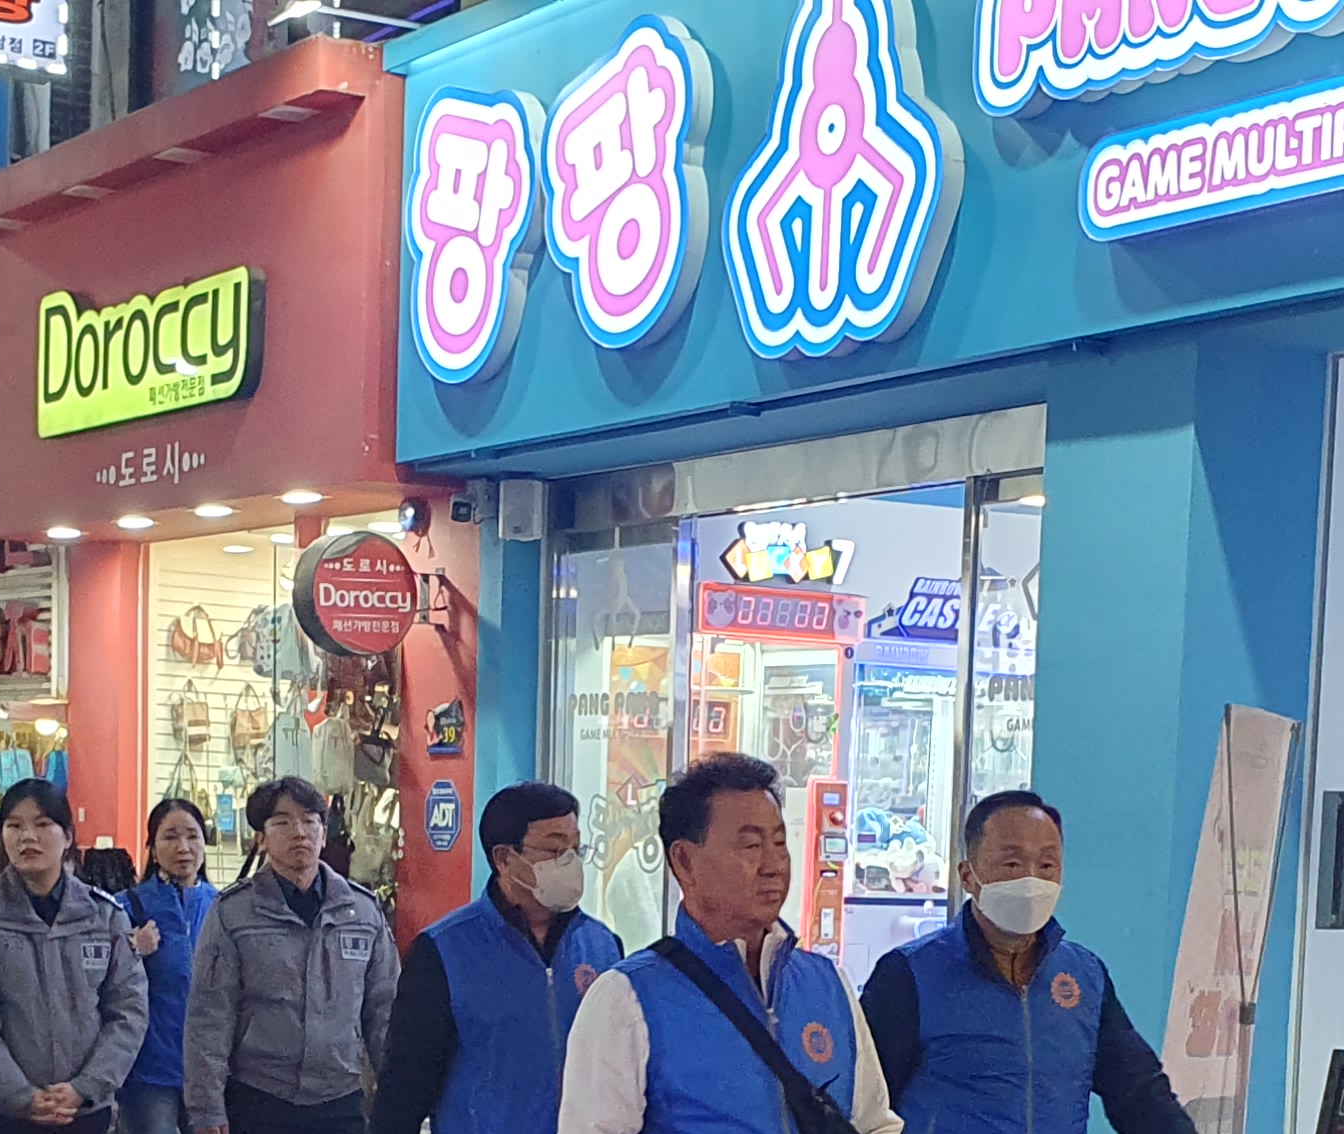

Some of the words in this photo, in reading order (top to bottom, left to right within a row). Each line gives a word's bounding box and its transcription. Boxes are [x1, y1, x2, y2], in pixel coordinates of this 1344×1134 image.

[34, 40, 56, 58] 2F
[1097, 150, 1204, 211] GAME
[43, 281, 243, 404] Doroccy
[118, 440, 180, 487] 도로시
[342, 557, 387, 576] 도로시
[729, 543, 831, 582] LUCKY
[831, 539, 855, 585] 7
[318, 582, 412, 612] Doroccy
[332, 619, 400, 634] 패션가방전문점
[568, 692, 610, 717] PANG
[429, 802, 456, 828] ADT
